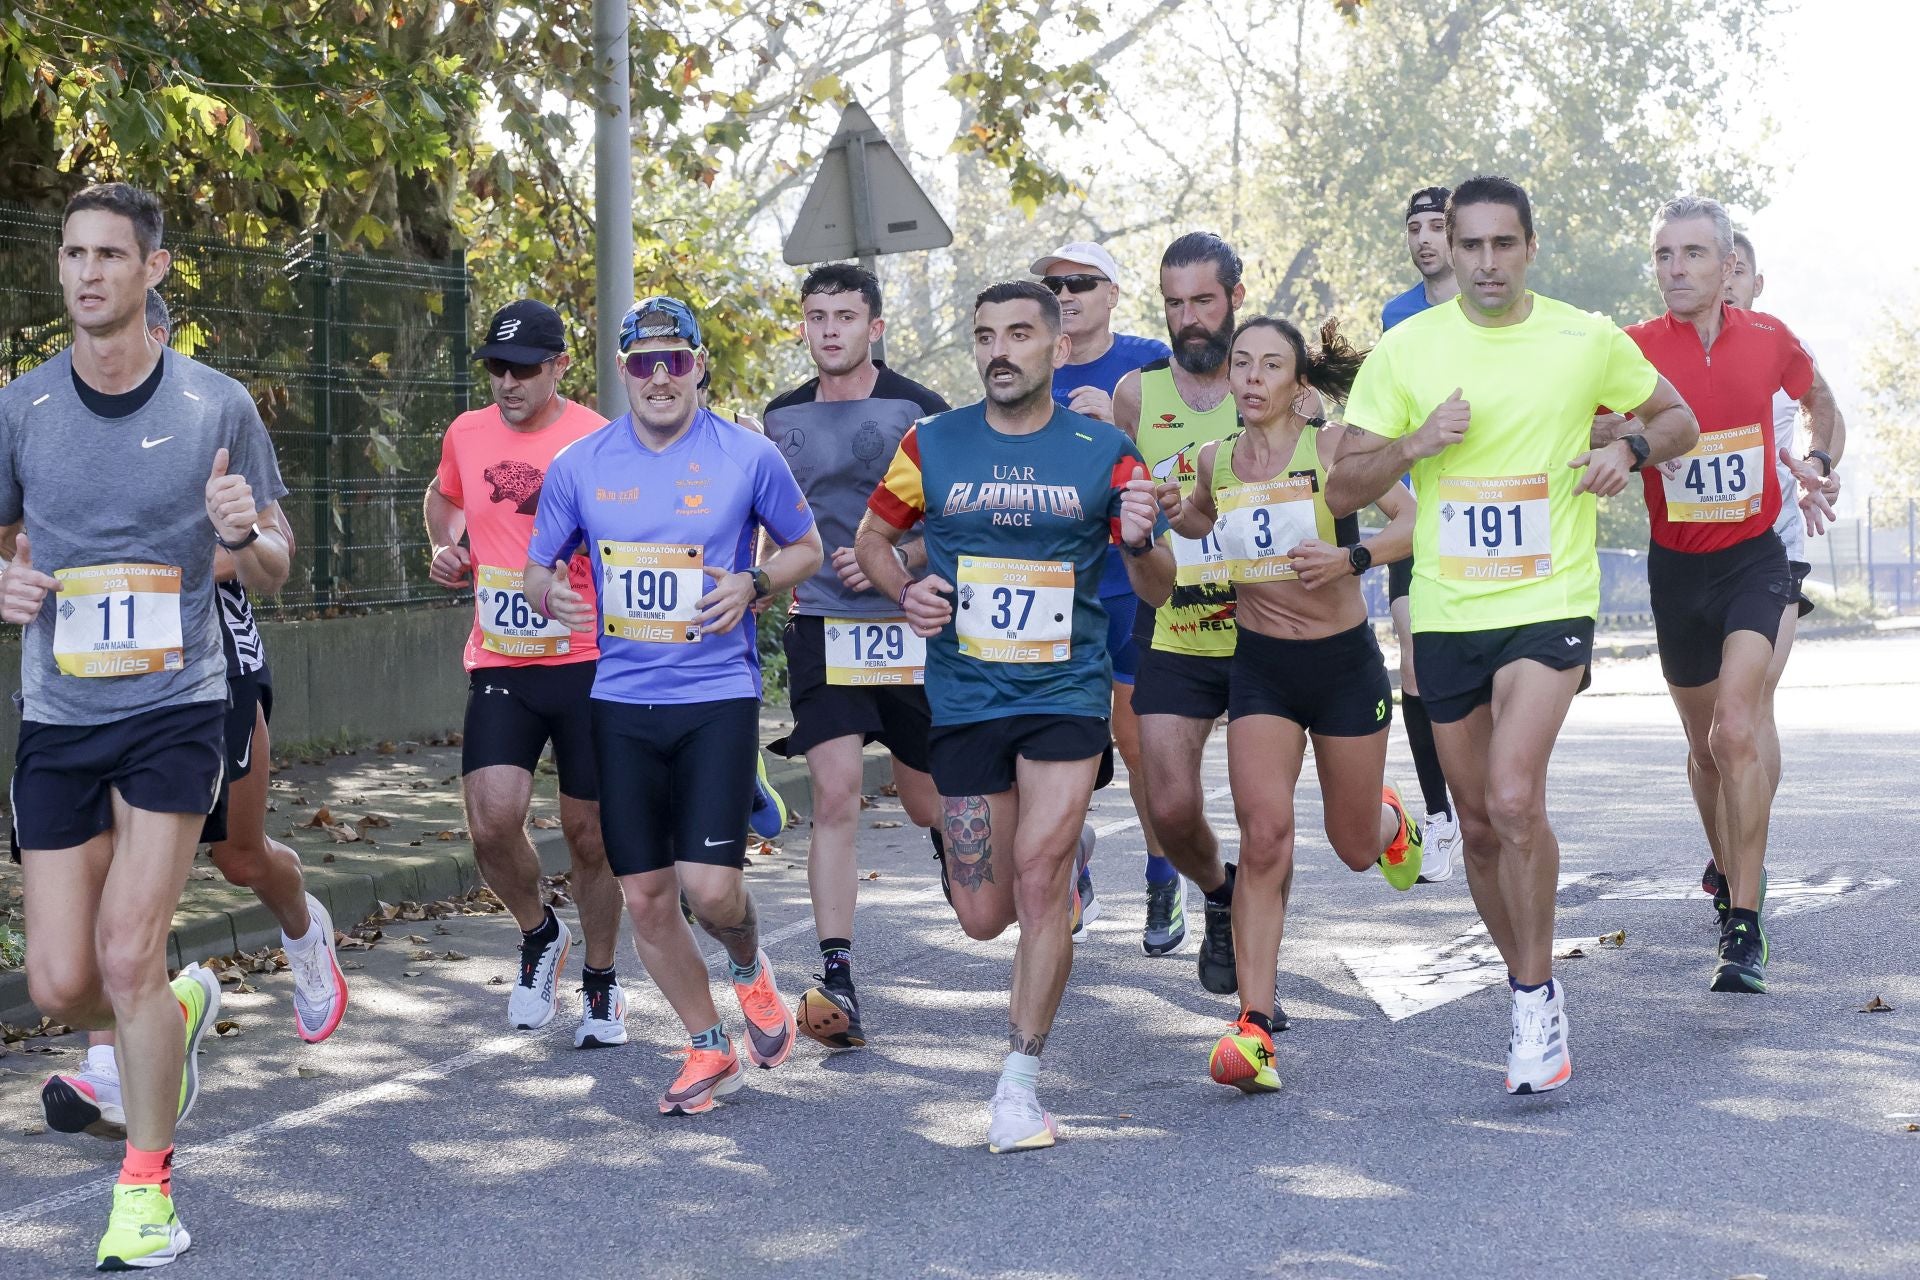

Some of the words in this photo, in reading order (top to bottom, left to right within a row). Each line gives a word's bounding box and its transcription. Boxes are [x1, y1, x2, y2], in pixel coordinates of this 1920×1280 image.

[1702, 443, 1724, 452] 2024
[992, 465, 1036, 481] UAR
[1685, 453, 1746, 495] 413
[1249, 494, 1271, 503] 2024
[1479, 491, 1503, 499] 2024
[1715, 493, 1736, 502] CARLOS
[943, 482, 1084, 521] GLADIATOR
[992, 512, 1032, 527] RACE
[1252, 508, 1273, 549] 3
[1463, 504, 1523, 548] 191
[616, 545, 638, 553] MEDIA
[639, 544, 676, 554] MARATÓN
[1257, 548, 1275, 557] ALICIA
[1487, 549, 1499, 557] VITI
[636, 556, 658, 565] 2024
[1204, 554, 1212, 562] UP
[106, 566, 149, 577] MARATÓN
[149, 566, 178, 577] AVILÉS
[983, 562, 1006, 570] MEDIA
[1007, 563, 1046, 572] MARATÓN
[1003, 573, 1027, 582] 2024
[103, 578, 128, 590] 2024
[620, 569, 678, 611] 190
[991, 587, 1036, 631] 37
[97, 594, 135, 641] 11
[643, 611, 666, 620] RUNNER
[1199, 620, 1237, 632] REL
[93, 642, 110, 651] JUAN
[110, 640, 139, 650] MANUEL
[848, 625, 904, 660] 129
